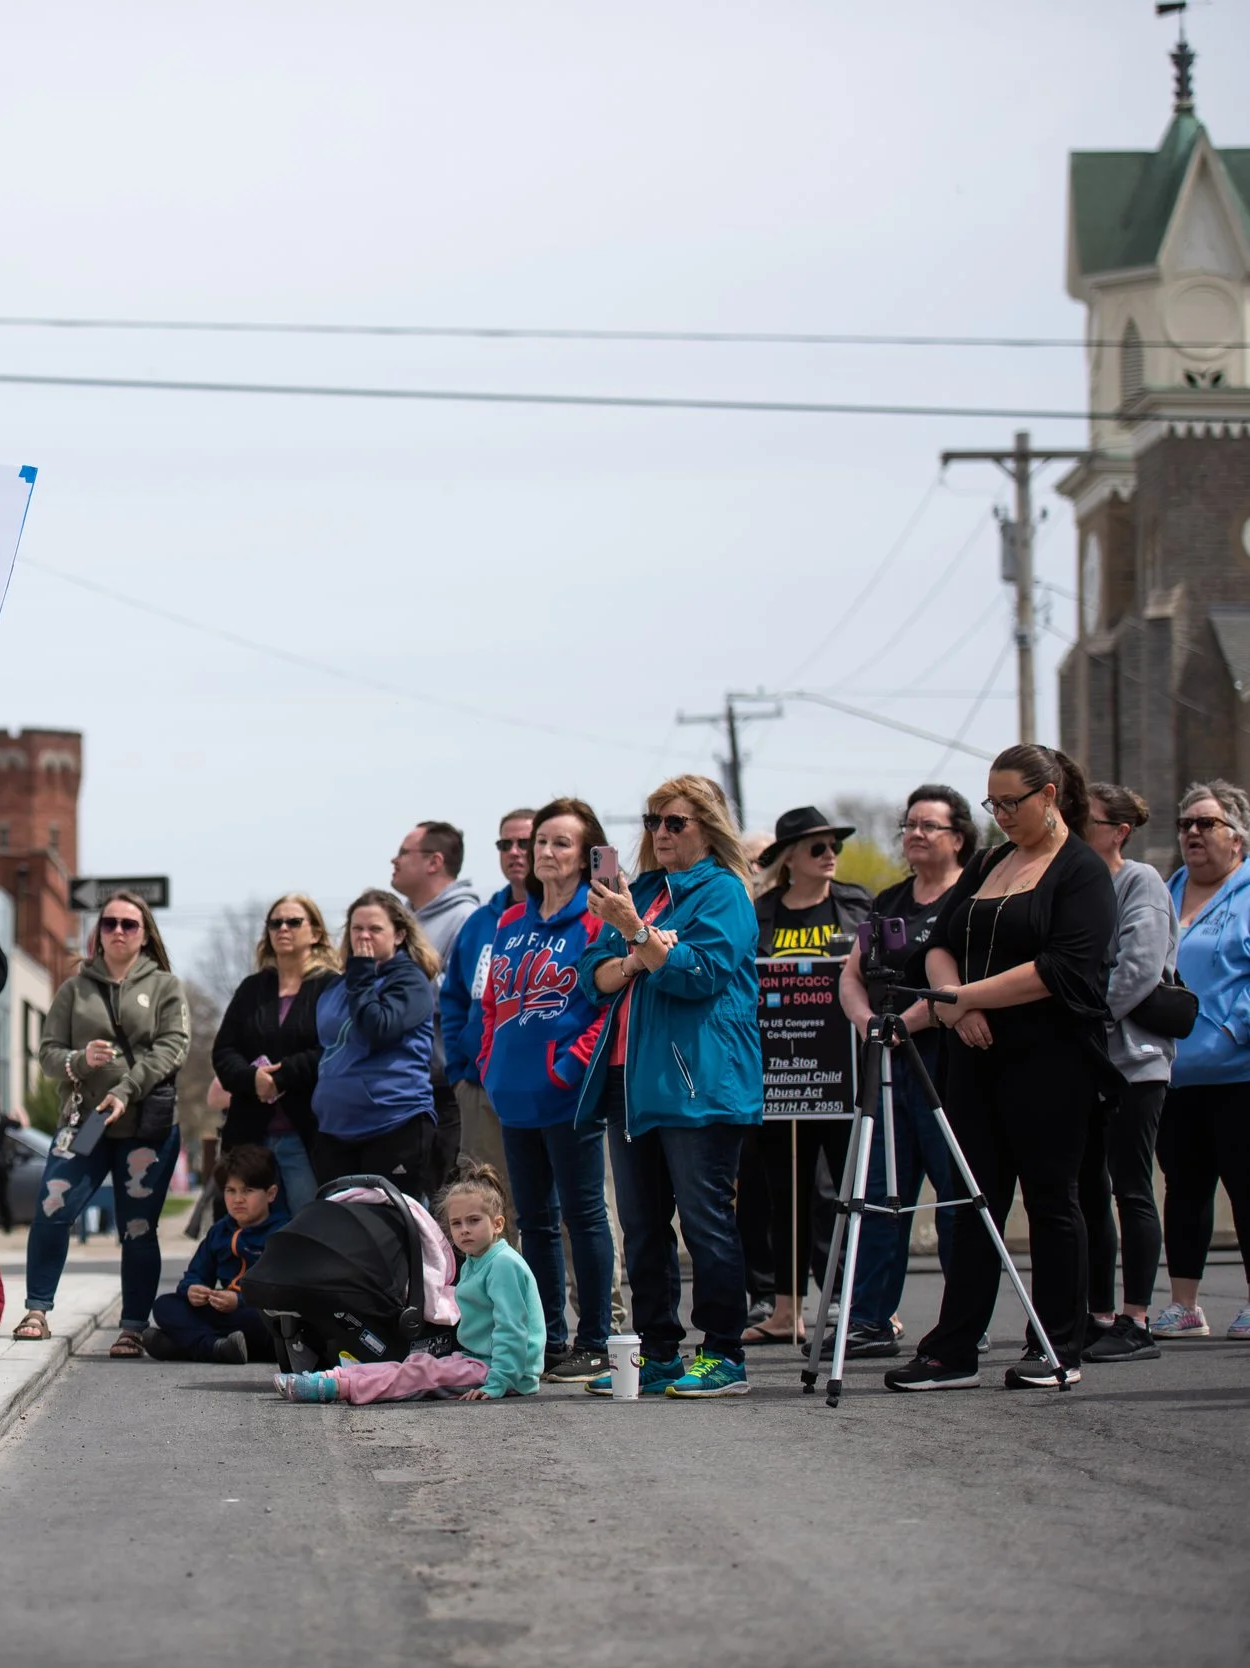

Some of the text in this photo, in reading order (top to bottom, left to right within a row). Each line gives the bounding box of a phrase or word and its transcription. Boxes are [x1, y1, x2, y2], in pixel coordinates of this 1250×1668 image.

[772, 923, 843, 949] IRVAN
[505, 932, 567, 954] BUFLO
[766, 961, 796, 973] TEXT
[793, 991, 833, 1005] 50409
[771, 1019, 783, 1028] US
[785, 1018, 825, 1029] Congress
[767, 1030, 817, 1040] Co-Sponsor
[769, 1057, 818, 1069] The Stop
[813, 1071, 843, 1083] Child
[766, 1087, 823, 1099] Abuse Act
